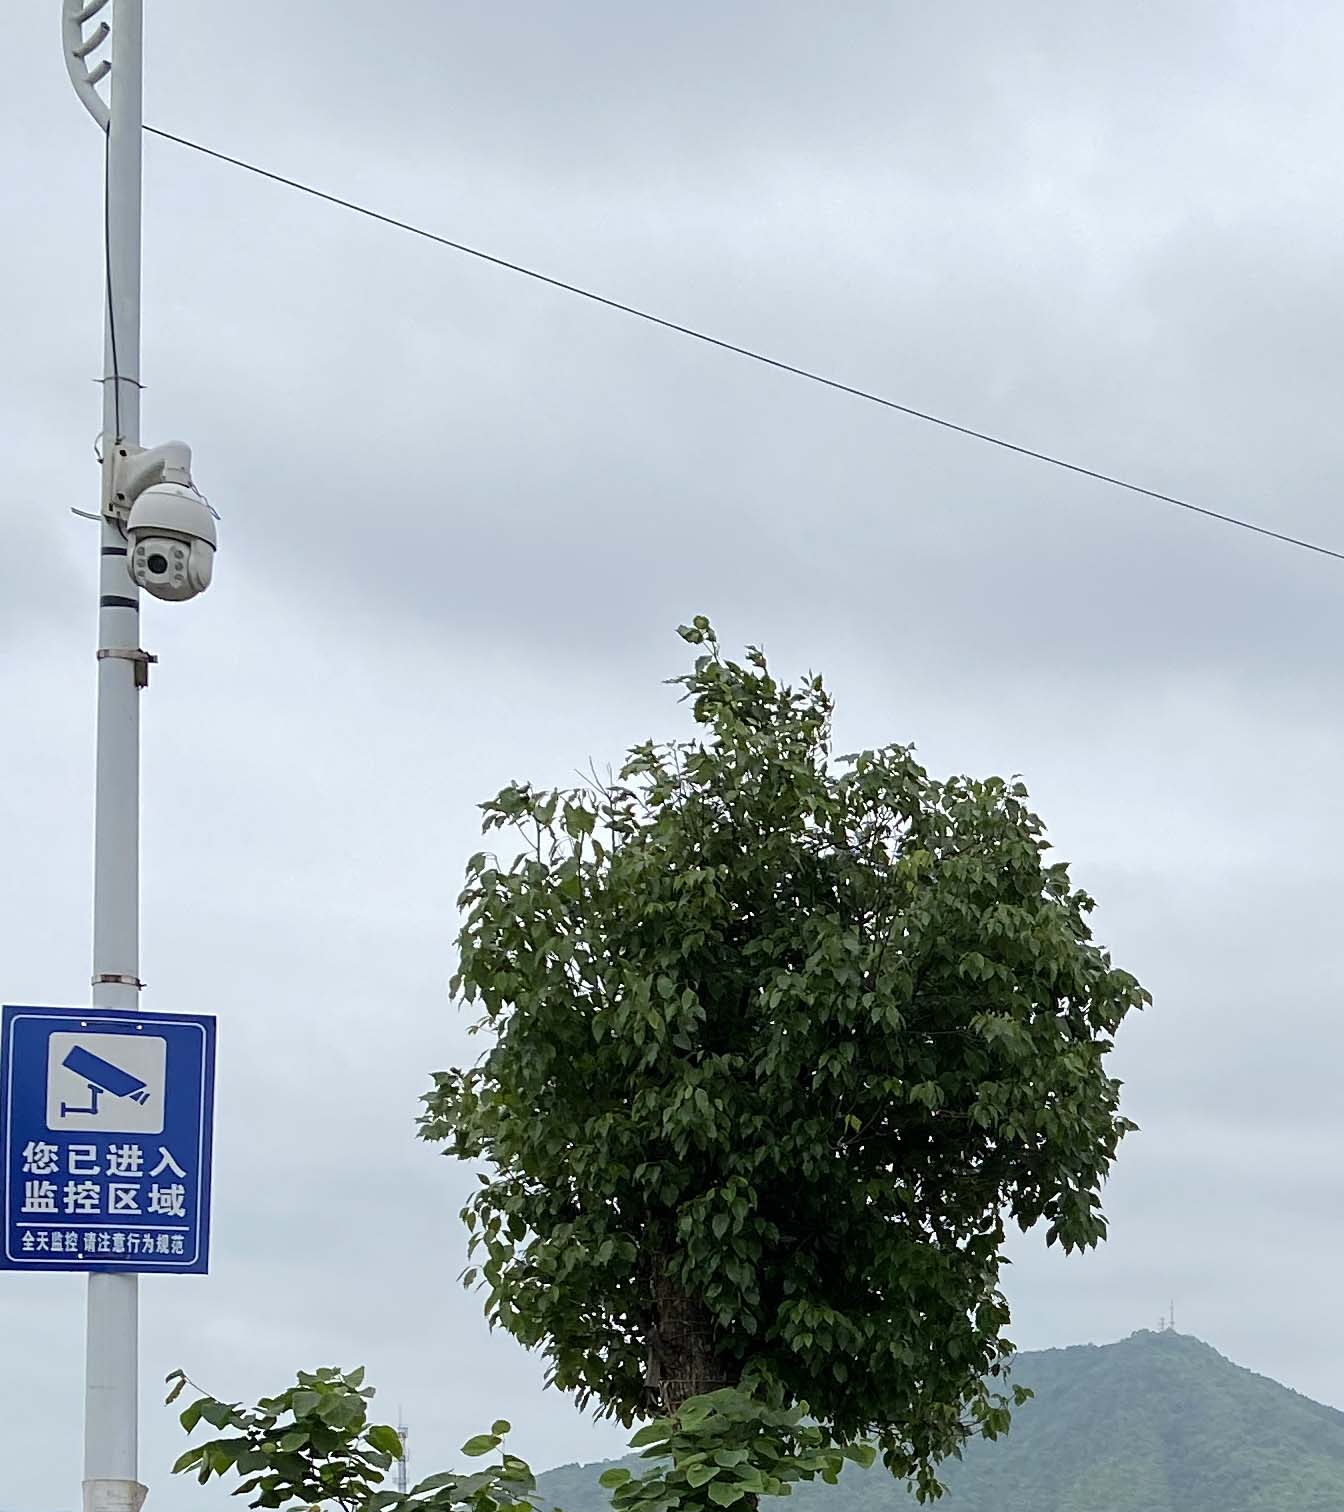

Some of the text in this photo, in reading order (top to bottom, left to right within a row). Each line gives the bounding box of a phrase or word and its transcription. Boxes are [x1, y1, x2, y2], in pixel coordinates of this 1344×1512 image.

[22, 1141, 187, 1178] 您已进入
[20, 1180, 186, 1217] 监控区域
[21, 1230, 185, 1255] 全天监控 请注意行为规范
